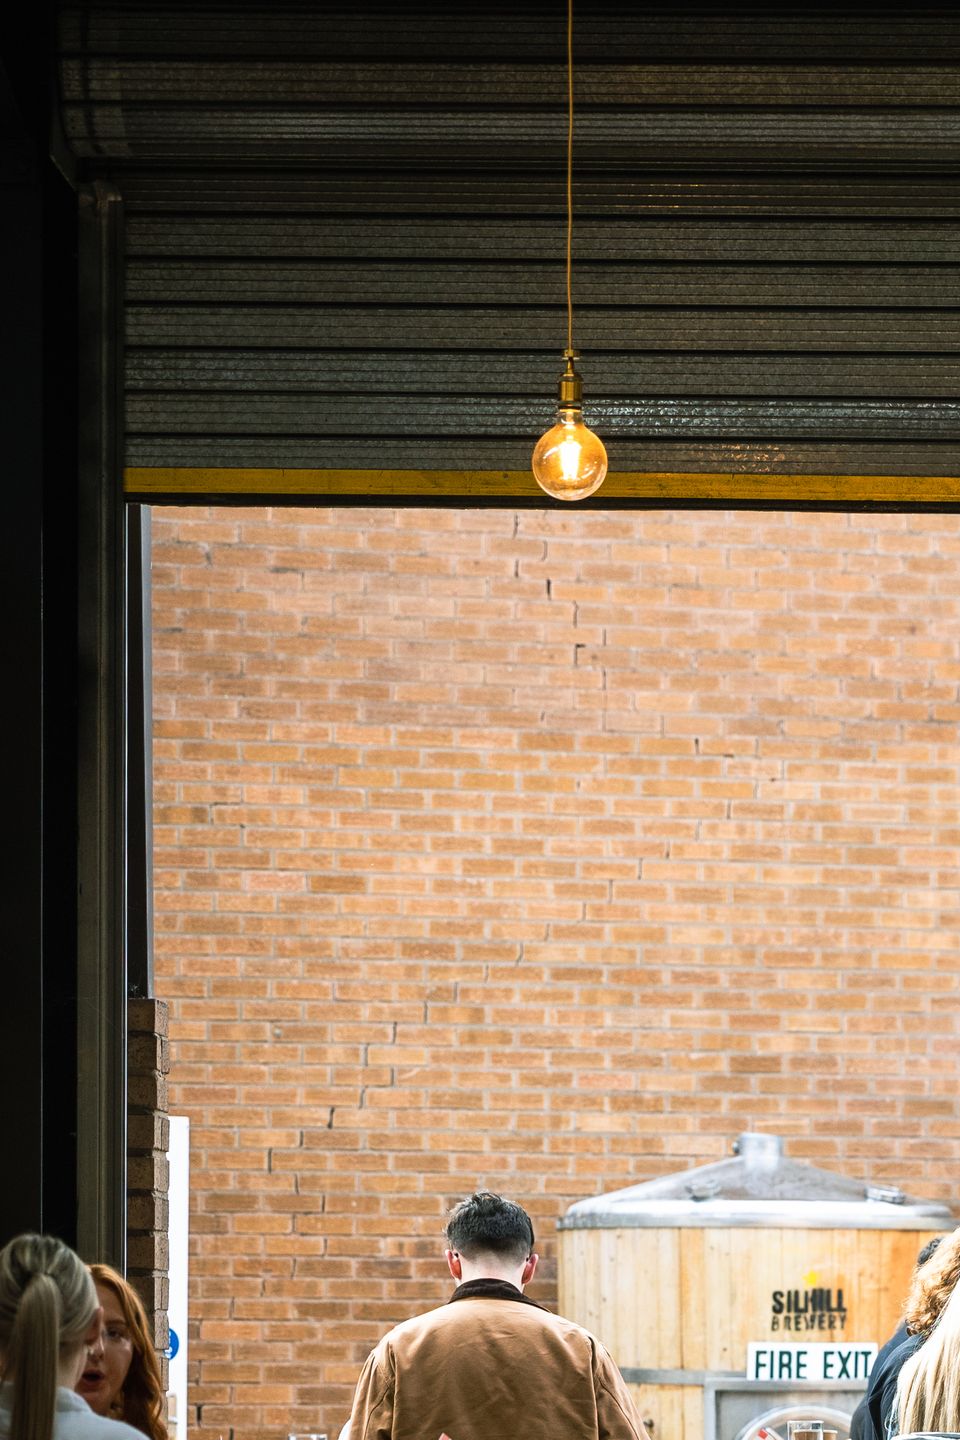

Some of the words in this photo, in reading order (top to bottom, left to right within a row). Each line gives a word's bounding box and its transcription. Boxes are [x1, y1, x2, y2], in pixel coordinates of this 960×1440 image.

[772, 1288, 847, 1314] SILHILL
[771, 1313, 847, 1331] BREWERY
[755, 1350, 808, 1379] FIRE
[823, 1351, 872, 1379] EXIT
